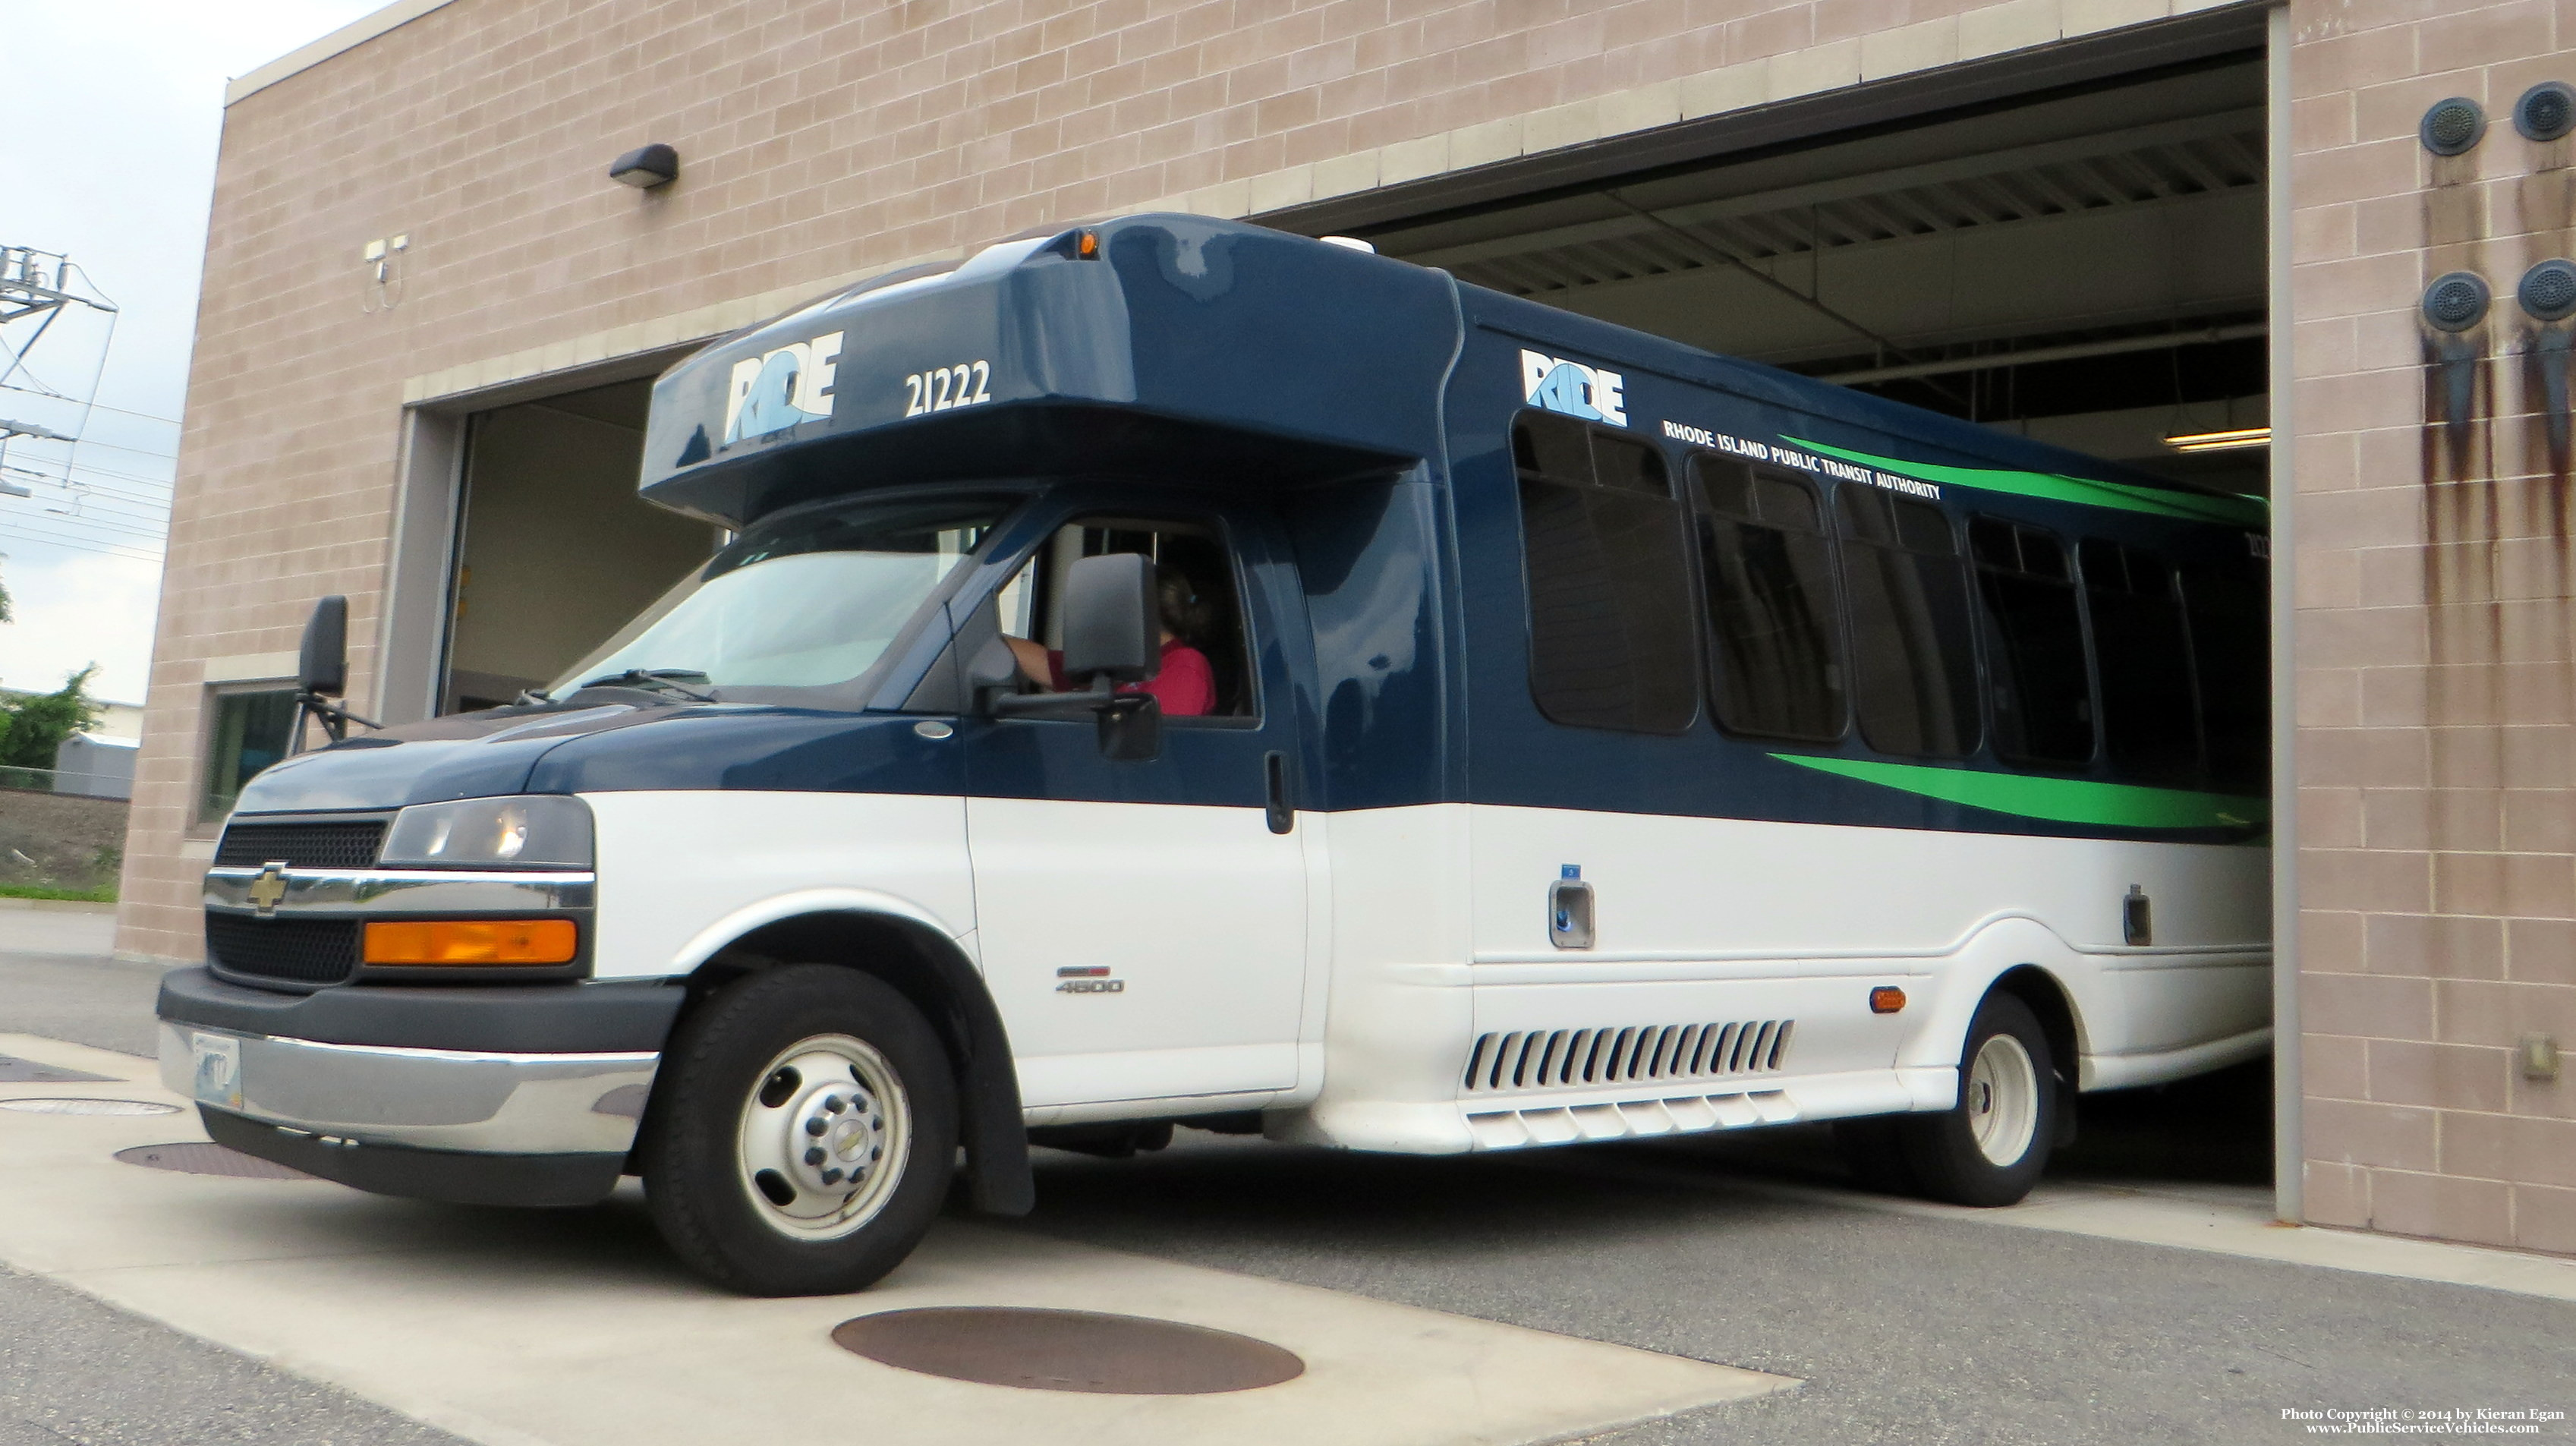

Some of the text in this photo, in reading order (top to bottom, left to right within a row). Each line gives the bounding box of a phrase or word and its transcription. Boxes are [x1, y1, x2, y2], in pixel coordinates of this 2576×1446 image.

[905, 360, 991, 417] 21222
[1521, 348, 1627, 427] RIDE
[1663, 420, 1941, 500] RHODE ISLAND PUBLIC TRANSIT AUTHORITY
